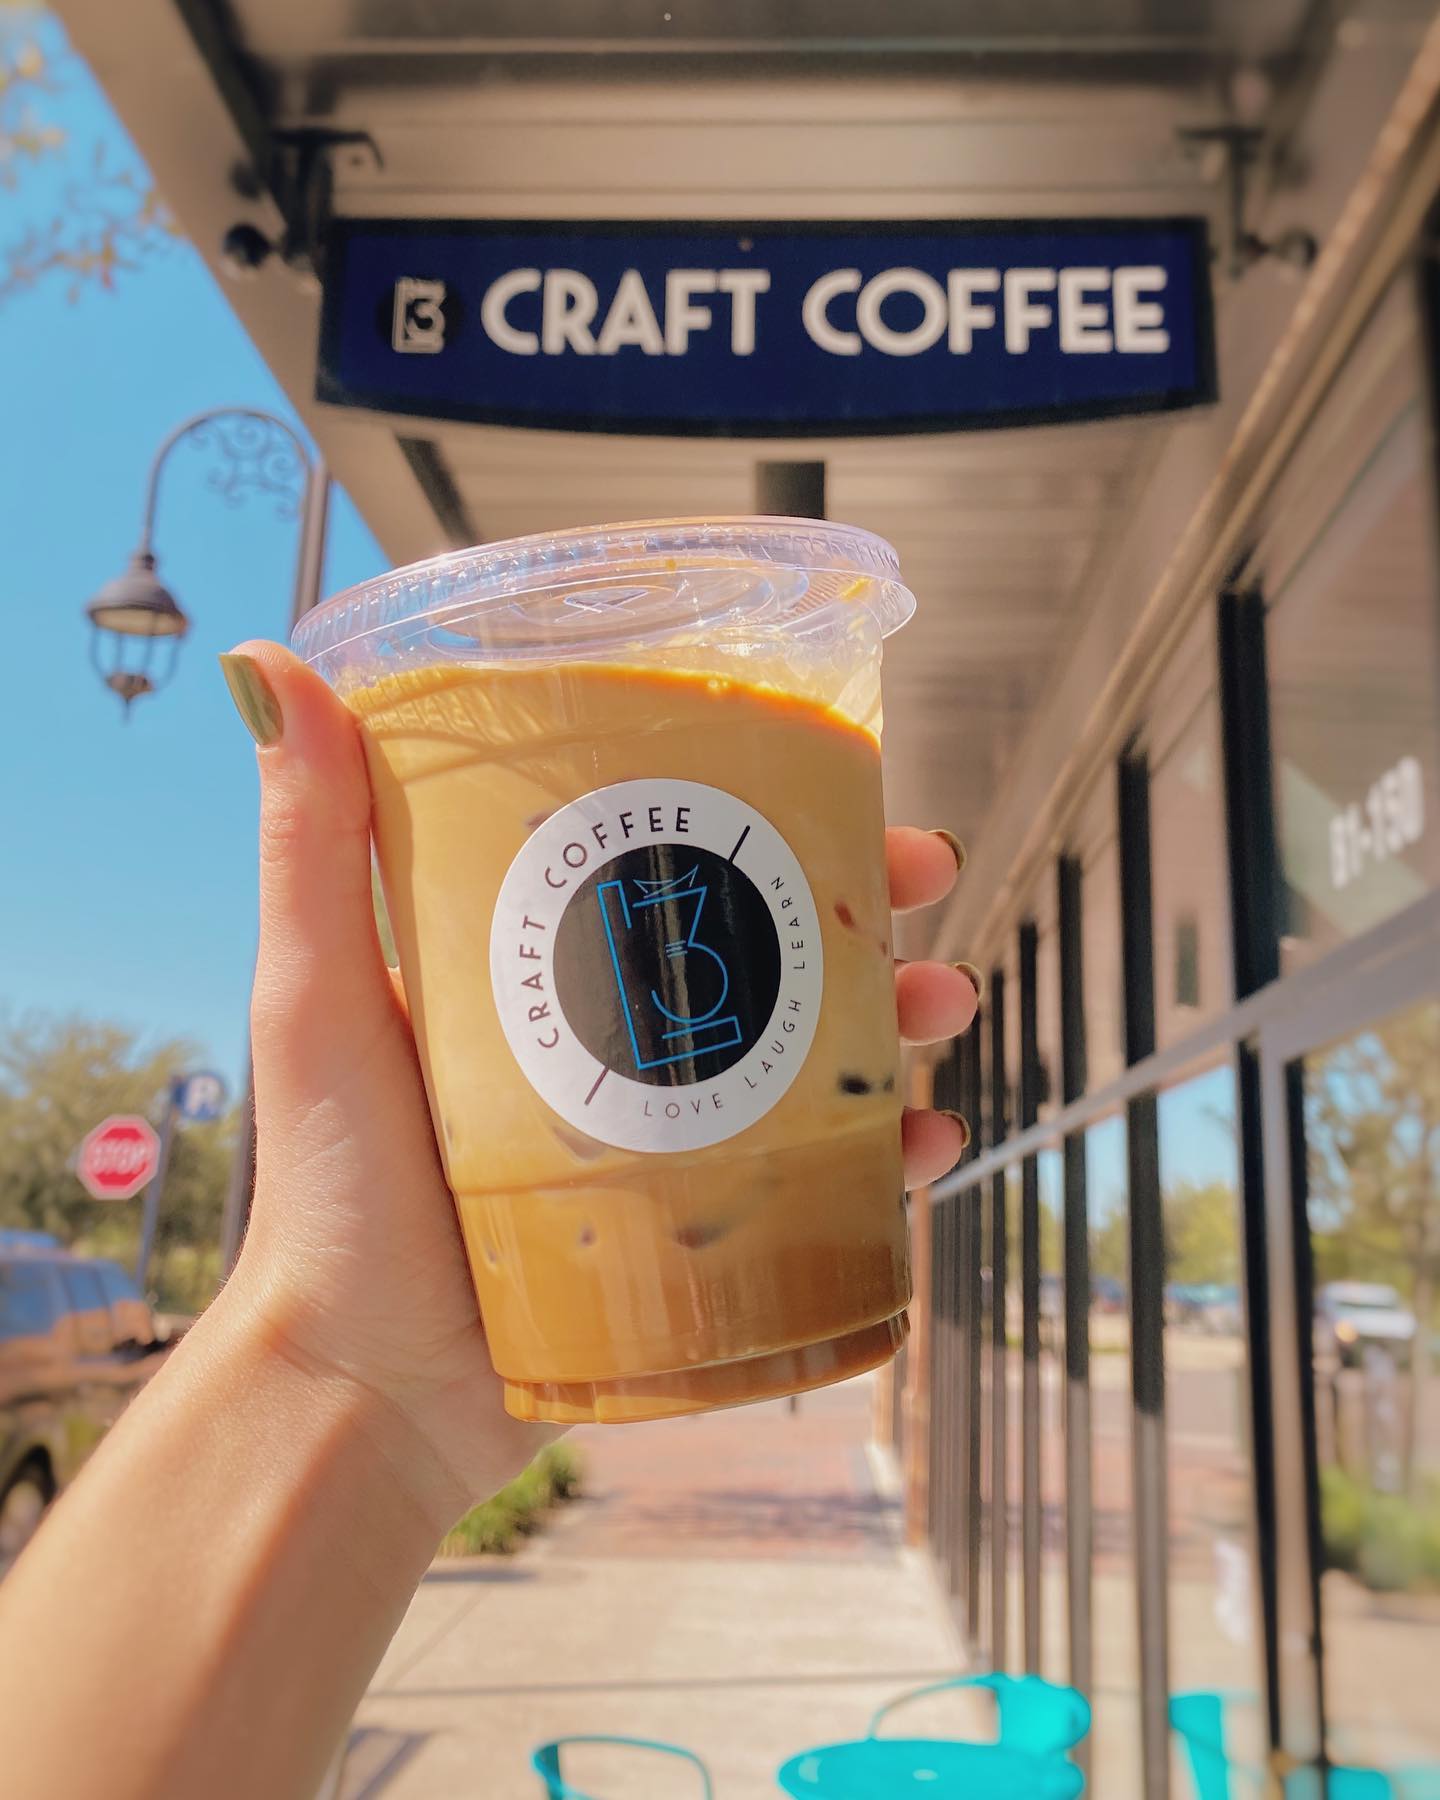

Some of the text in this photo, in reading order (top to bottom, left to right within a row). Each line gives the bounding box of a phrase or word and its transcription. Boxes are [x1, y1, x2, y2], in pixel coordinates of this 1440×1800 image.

[481, 268, 770, 356] CRAFT
[802, 266, 1171, 356] COFFEE
[518, 806, 692, 1050] CRAFT COFFEE
[643, 876, 806, 1119] LOVE LAUGH LEARN
[92, 1137, 152, 1175] STOP
